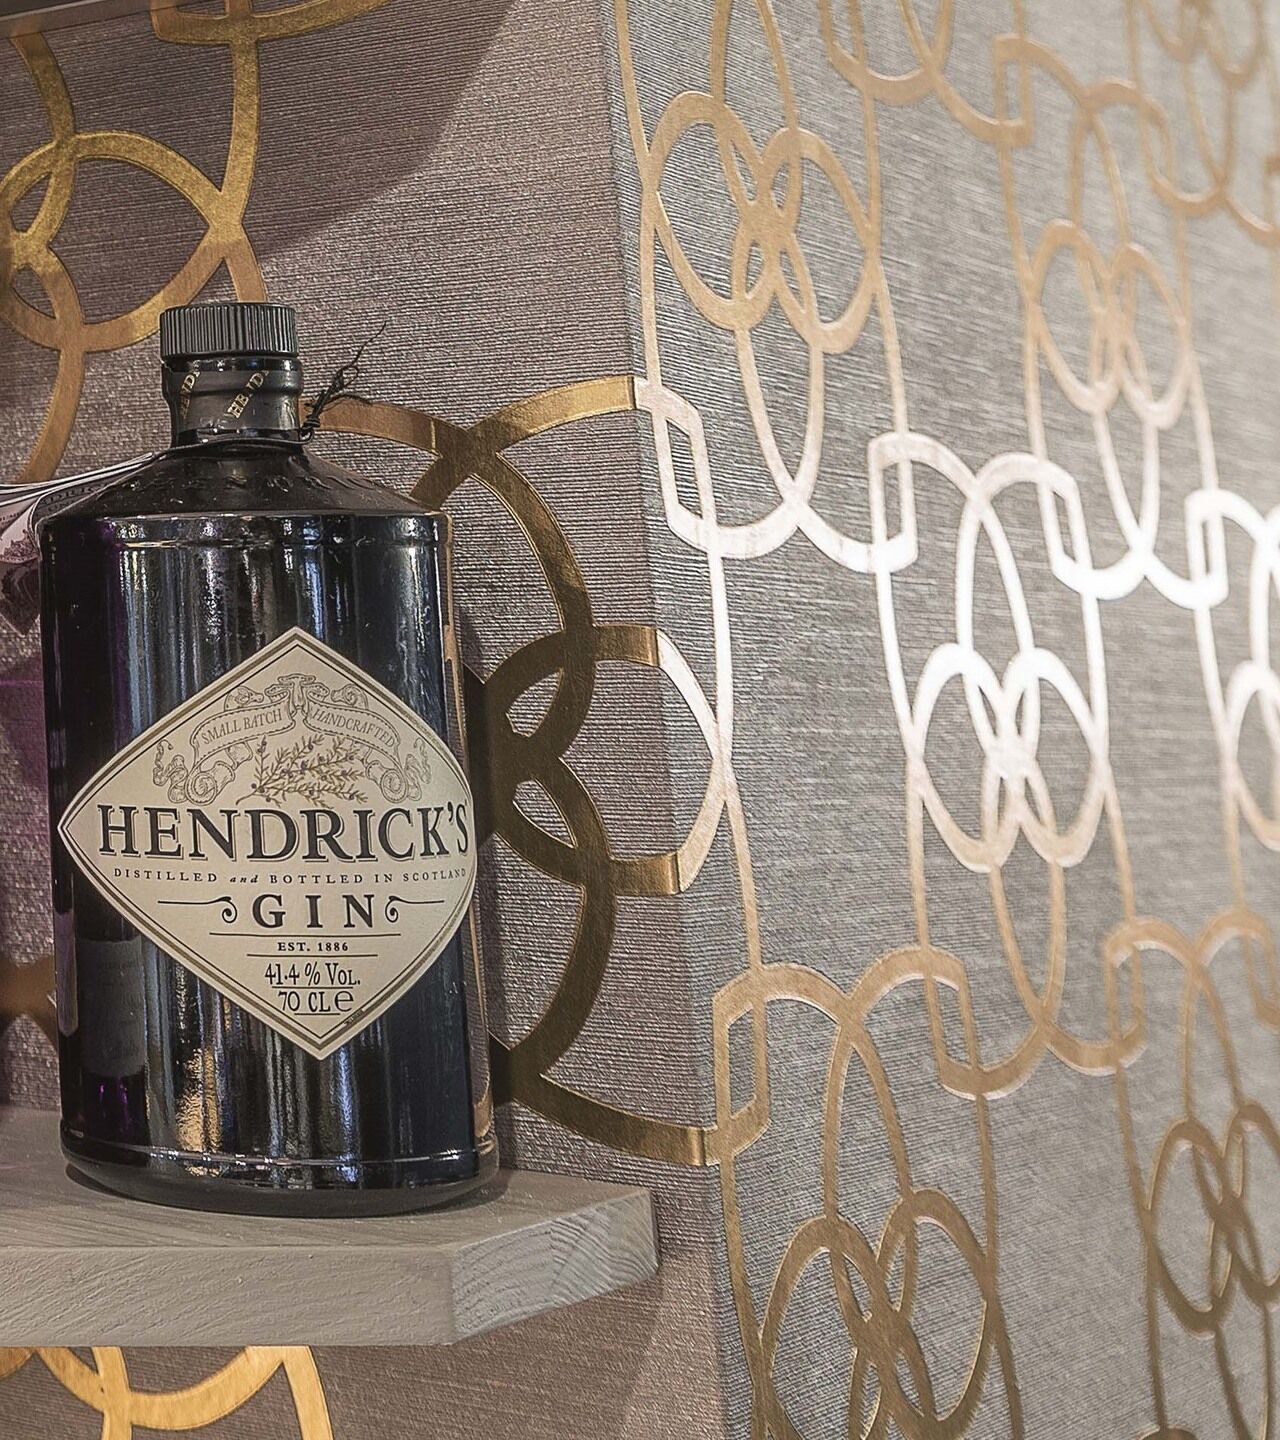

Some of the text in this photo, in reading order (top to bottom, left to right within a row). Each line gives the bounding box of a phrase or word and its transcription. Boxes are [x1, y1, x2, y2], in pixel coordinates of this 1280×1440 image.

[200, 708, 284, 745] SMALL BATCH
[313, 708, 397, 748] HANDCRAFTED
[96, 799, 470, 864] HENDRICK'S
[114, 868, 467, 885] DISTILLED and BOTTLED IN SCOTLAND
[252, 893, 375, 930] GIN
[277, 941, 349, 953] EST. 1886
[278, 990, 300, 1012] 70
